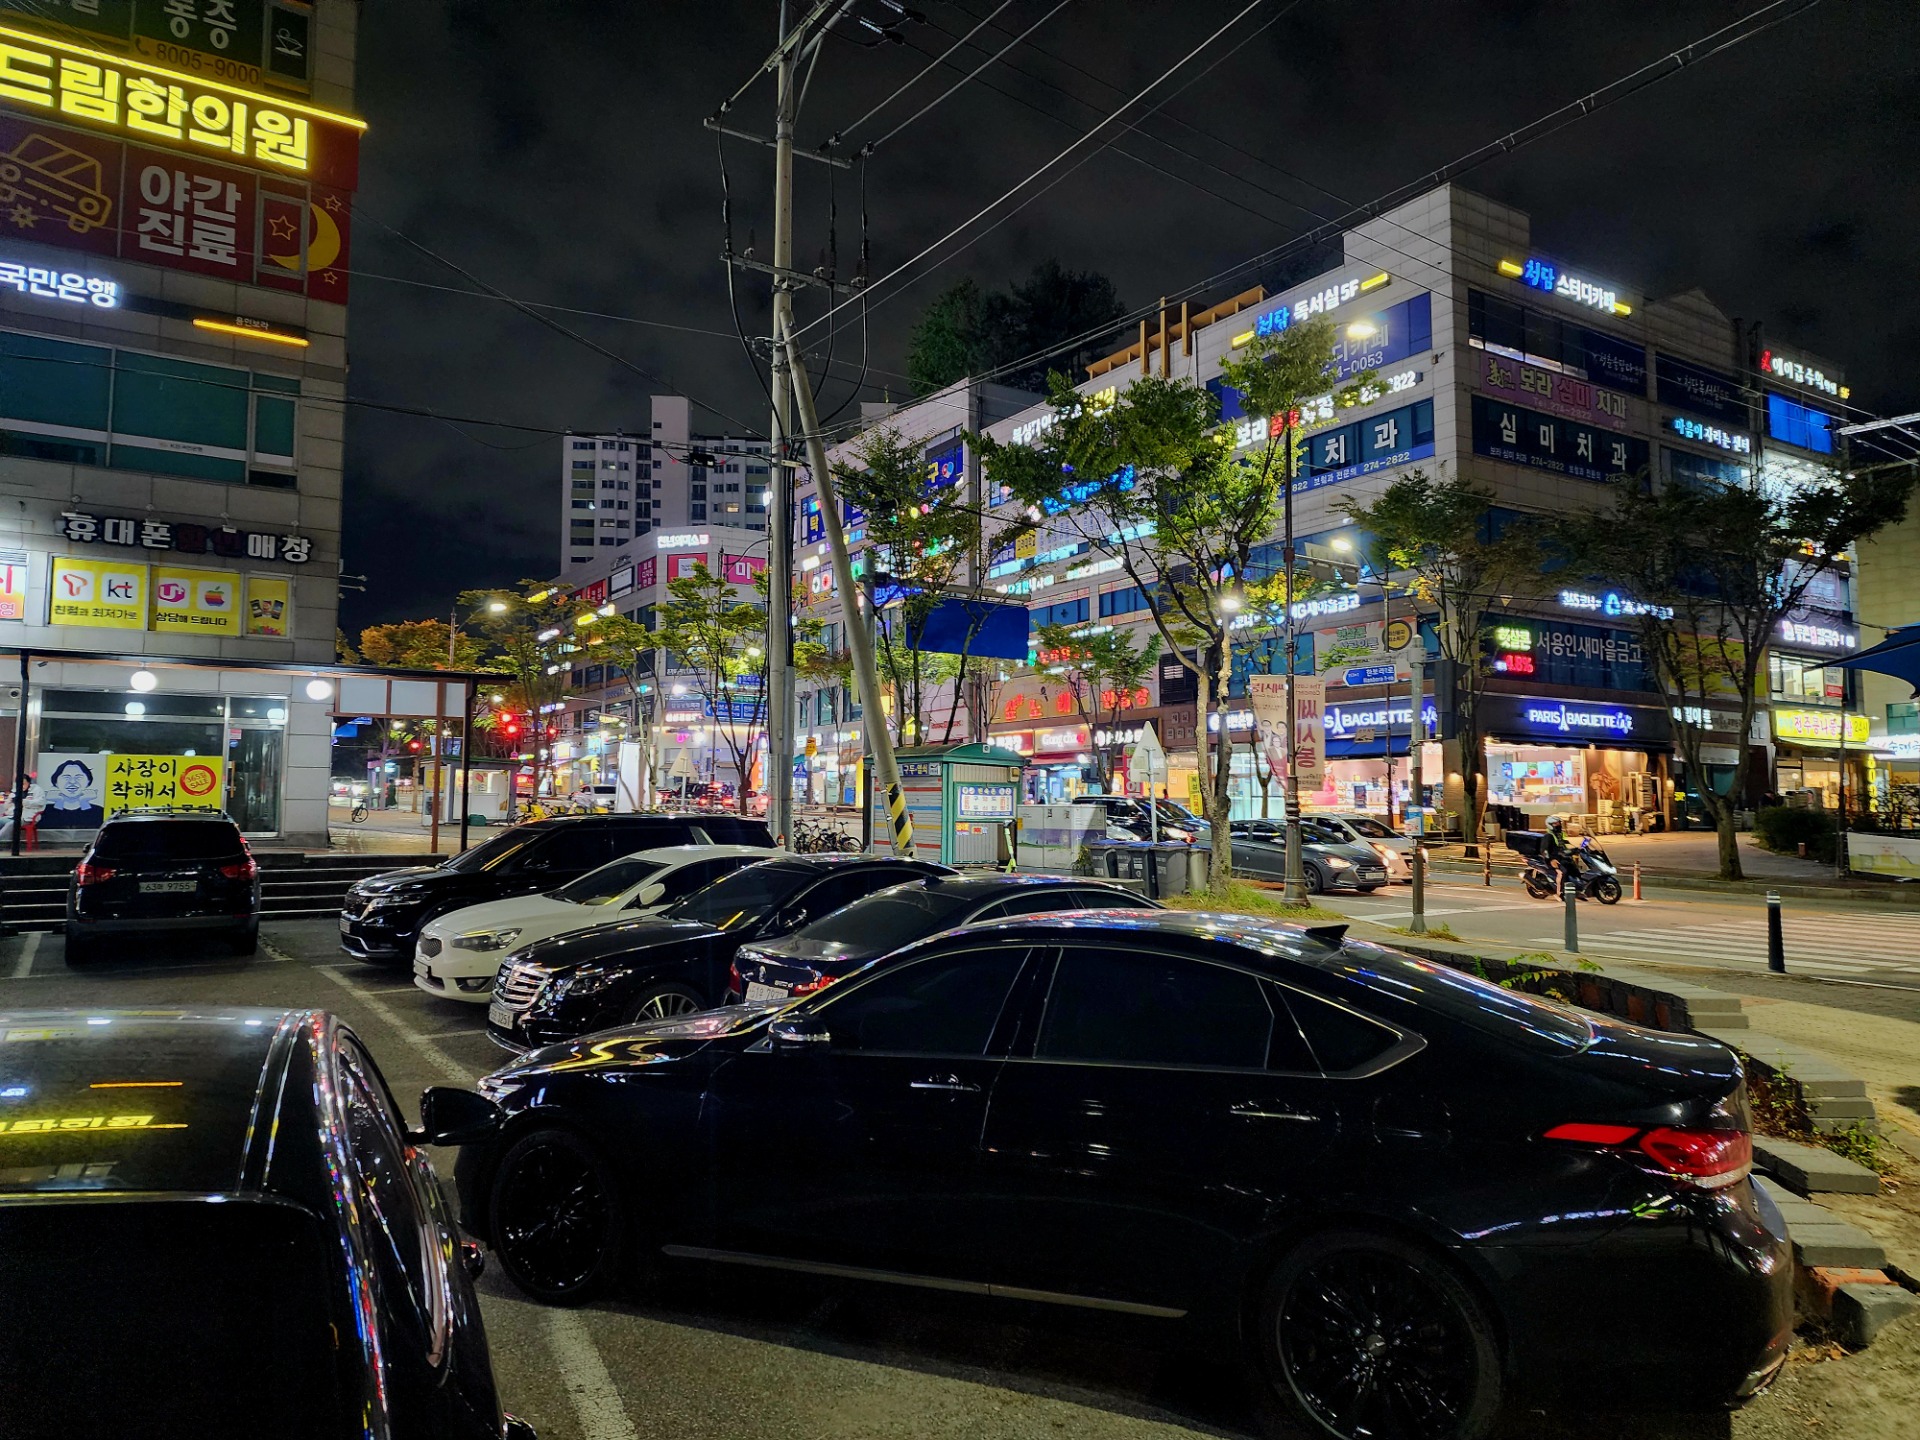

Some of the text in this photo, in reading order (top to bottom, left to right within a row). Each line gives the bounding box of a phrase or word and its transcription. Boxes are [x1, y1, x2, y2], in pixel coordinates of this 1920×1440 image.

[156, 44, 260, 84] 8005-9000
[0, 43, 308, 170] 드림한의원
[140, 166, 242, 223] 야간
[138, 208, 237, 265] 진료
[0, 262, 118, 308] 국민은행
[1525, 259, 1616, 312] 청담 스터디카페
[1331, 325, 1388, 361] 디카페
[1520, 366, 1553, 399] 보라
[1557, 378, 1591, 410] 심미
[1596, 389, 1627, 420] 치과
[1674, 418, 1703, 440] 마음이
[1325, 418, 1398, 464] 치 과
[1500, 412, 1627, 471] 심 미 치 과
[1363, 451, 1410, 472] 274-2822
[108, 579, 133, 598] kt
[92, 607, 138, 620] 최저가로
[190, 614, 228, 626] 드립니다
[1537, 631, 1643, 664] 서용인새마을금고
[1342, 709, 1413, 726] BAGUETTE
[1529, 709, 1560, 723] PARIS
[1566, 713, 1616, 728] BAGUETTE
[1794, 714, 1852, 737] 전주콩나물밥
[113, 758, 177, 778] 사장이
[112, 781, 176, 800] 착해서
[190, 779, 209, 789] SALE
[167, 882, 190, 890] 9755
